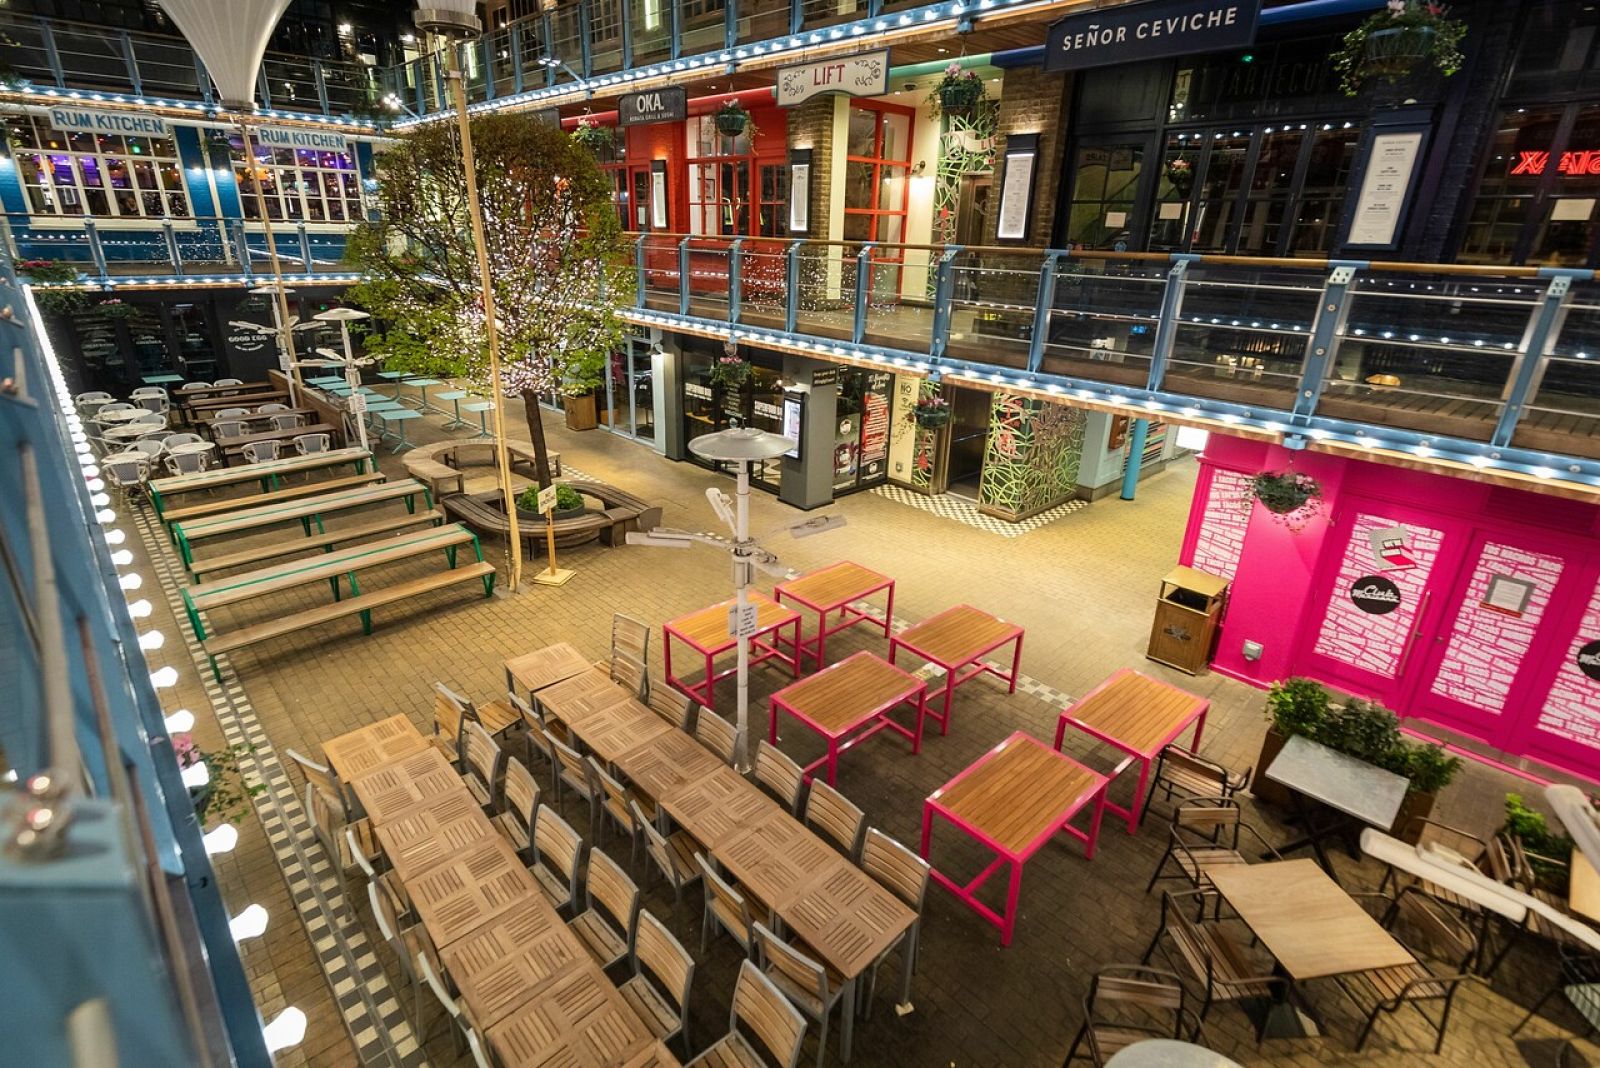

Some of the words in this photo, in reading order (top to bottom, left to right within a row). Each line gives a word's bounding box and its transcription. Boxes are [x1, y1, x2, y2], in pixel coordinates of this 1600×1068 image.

[1062, 24, 1126, 51] SEÑOR
[1136, 7, 1237, 39] CEVICHE
[813, 64, 845, 86] LIFT
[52, 110, 93, 128] RUM
[94, 115, 164, 133] KITCHEN
[260, 129, 290, 143] RUM
[292, 132, 345, 149] KITCHEN
